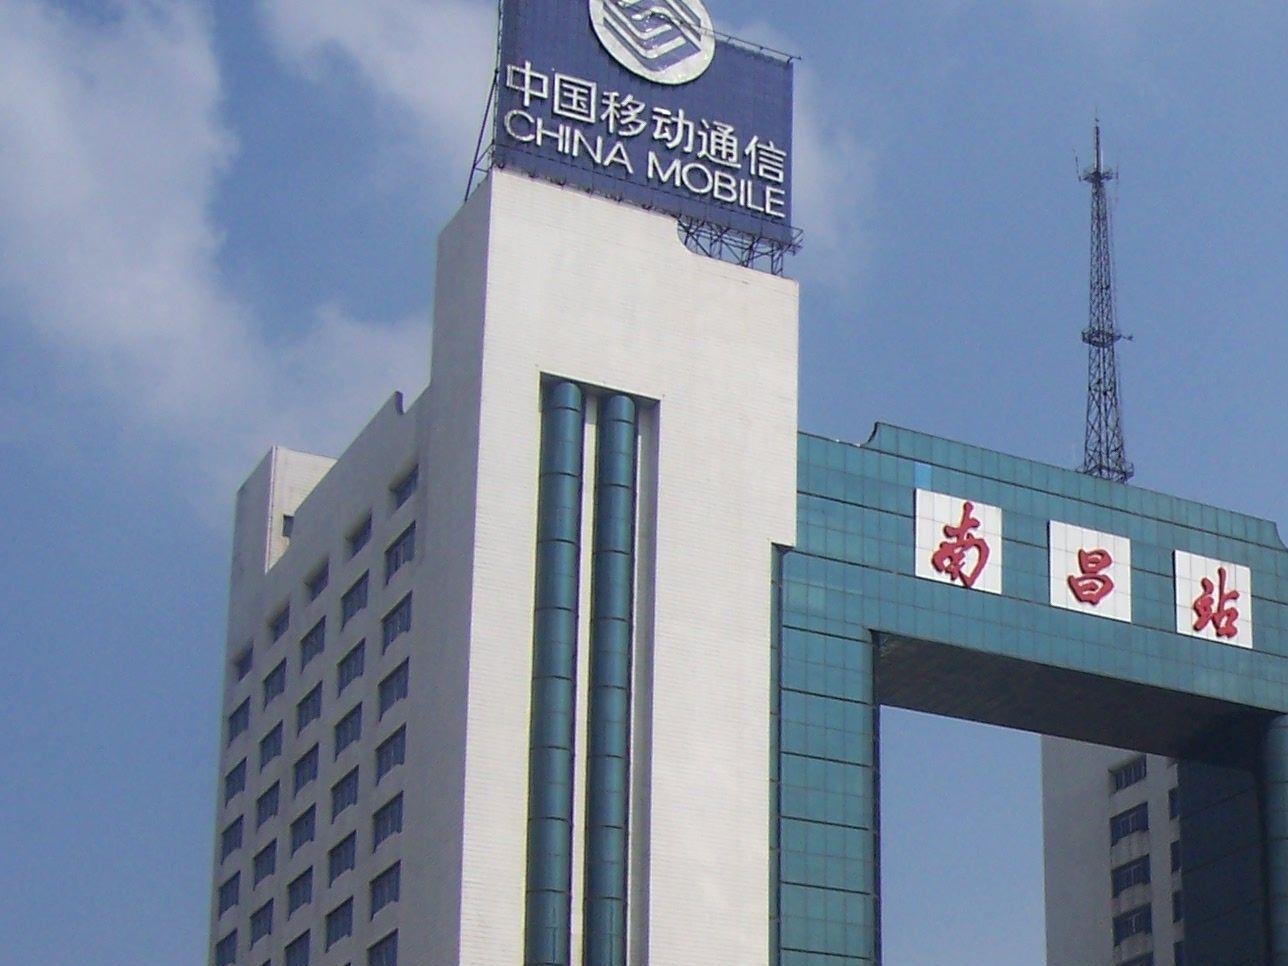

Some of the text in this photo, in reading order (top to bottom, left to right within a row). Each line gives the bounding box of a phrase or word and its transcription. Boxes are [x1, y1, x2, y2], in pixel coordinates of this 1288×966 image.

[503, 109, 786, 219] CHINA MOBILE
[505, 61, 788, 184] 中国移动通信
[931, 500, 1240, 638] 南昌站
